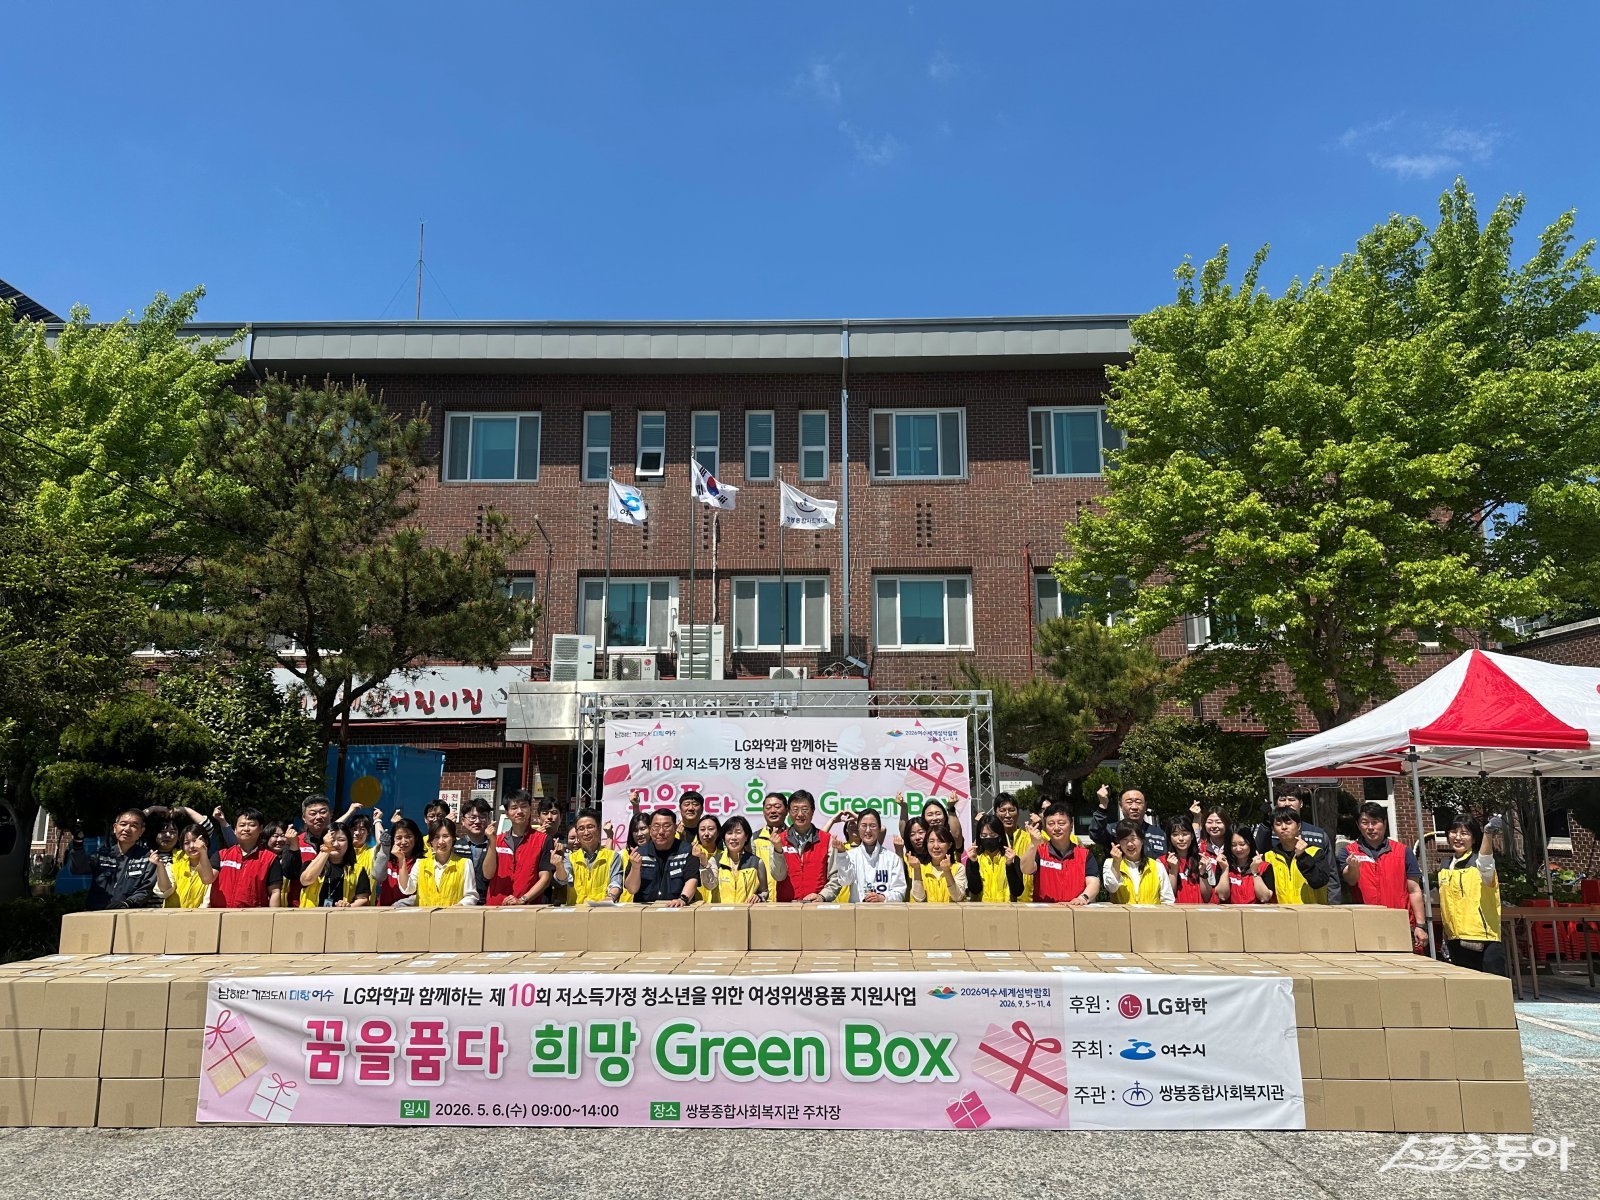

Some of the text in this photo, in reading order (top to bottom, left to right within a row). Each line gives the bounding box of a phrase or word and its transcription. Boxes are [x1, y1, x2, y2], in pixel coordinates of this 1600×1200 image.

[389, 688, 483, 715] 어린이집
[734, 739, 838, 753] LG화학과 함께하는
[641, 755, 929, 771] 제10회 저소득가정 청소년을 위한 여성위생용품 지원사업
[820, 792, 898, 815] Green
[218, 987, 250, 1000] 남해안
[251, 988, 287, 1001] 거점도시
[343, 983, 917, 1008] LG화학과 함께하는 제10회 저소득가정 청소년을 위한 여성위생용품 지원사업
[960, 987, 1051, 998] 2026여수세계섬박람회
[1069, 995, 1101, 1014] 후원
[1146, 997, 1208, 1015] LG화학
[304, 1018, 956, 1083] 꿈을품다 희망 Green Box
[1071, 1040, 1103, 1059] 주최
[1160, 1043, 1206, 1058] 여수시
[1074, 1085, 1106, 1105] 주관
[1159, 1084, 1285, 1102] 쌍봉종합사회복지관
[403, 1102, 427, 1117] 일시
[531, 1104, 619, 1118] 09:00~14:00
[653, 1104, 842, 1121] 장소 쌍봉종합사회복지관 주차장
